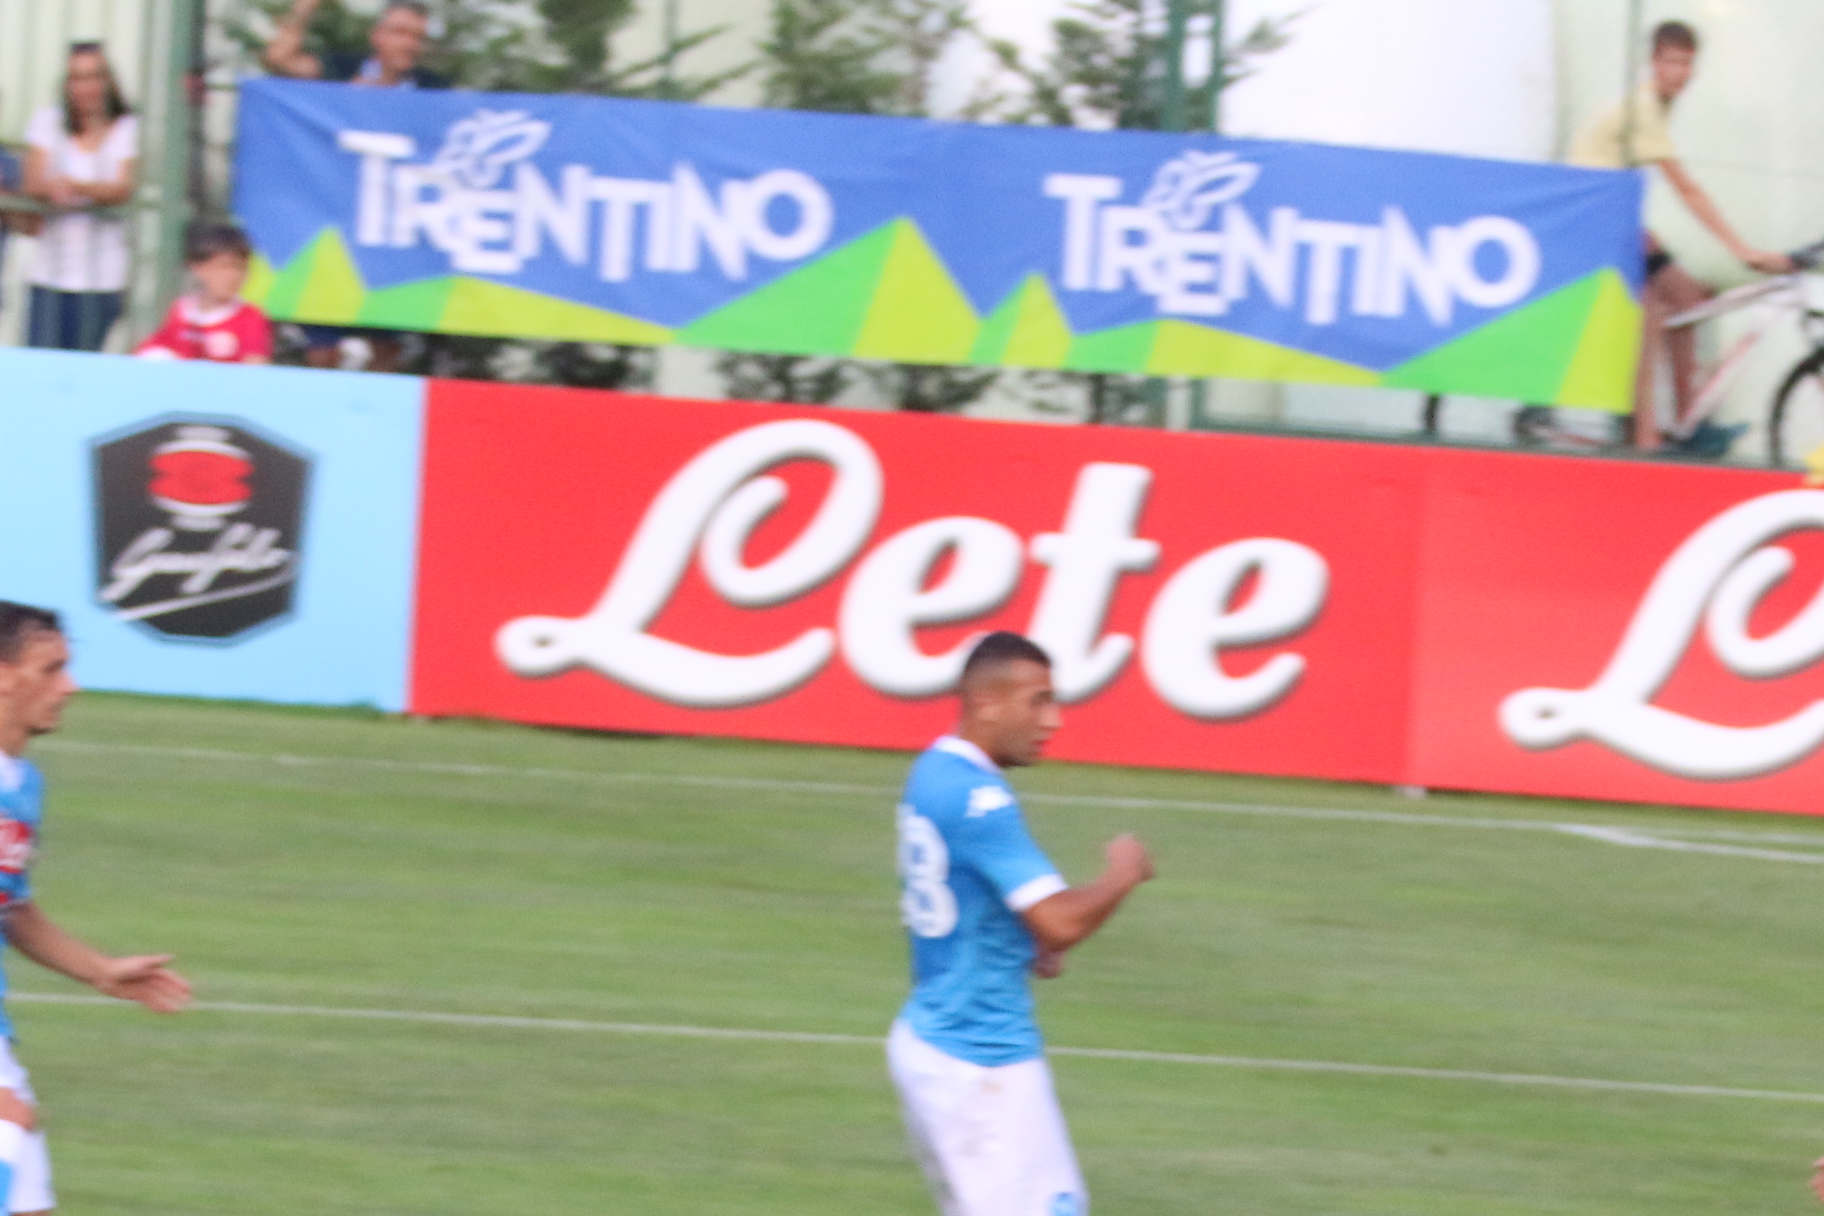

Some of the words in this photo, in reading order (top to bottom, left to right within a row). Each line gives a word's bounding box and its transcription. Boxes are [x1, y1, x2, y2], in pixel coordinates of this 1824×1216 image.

[338, 130, 834, 281] TRENTINO
[1044, 174, 1541, 326] TRENTINO
[495, 419, 1330, 720] Lete
